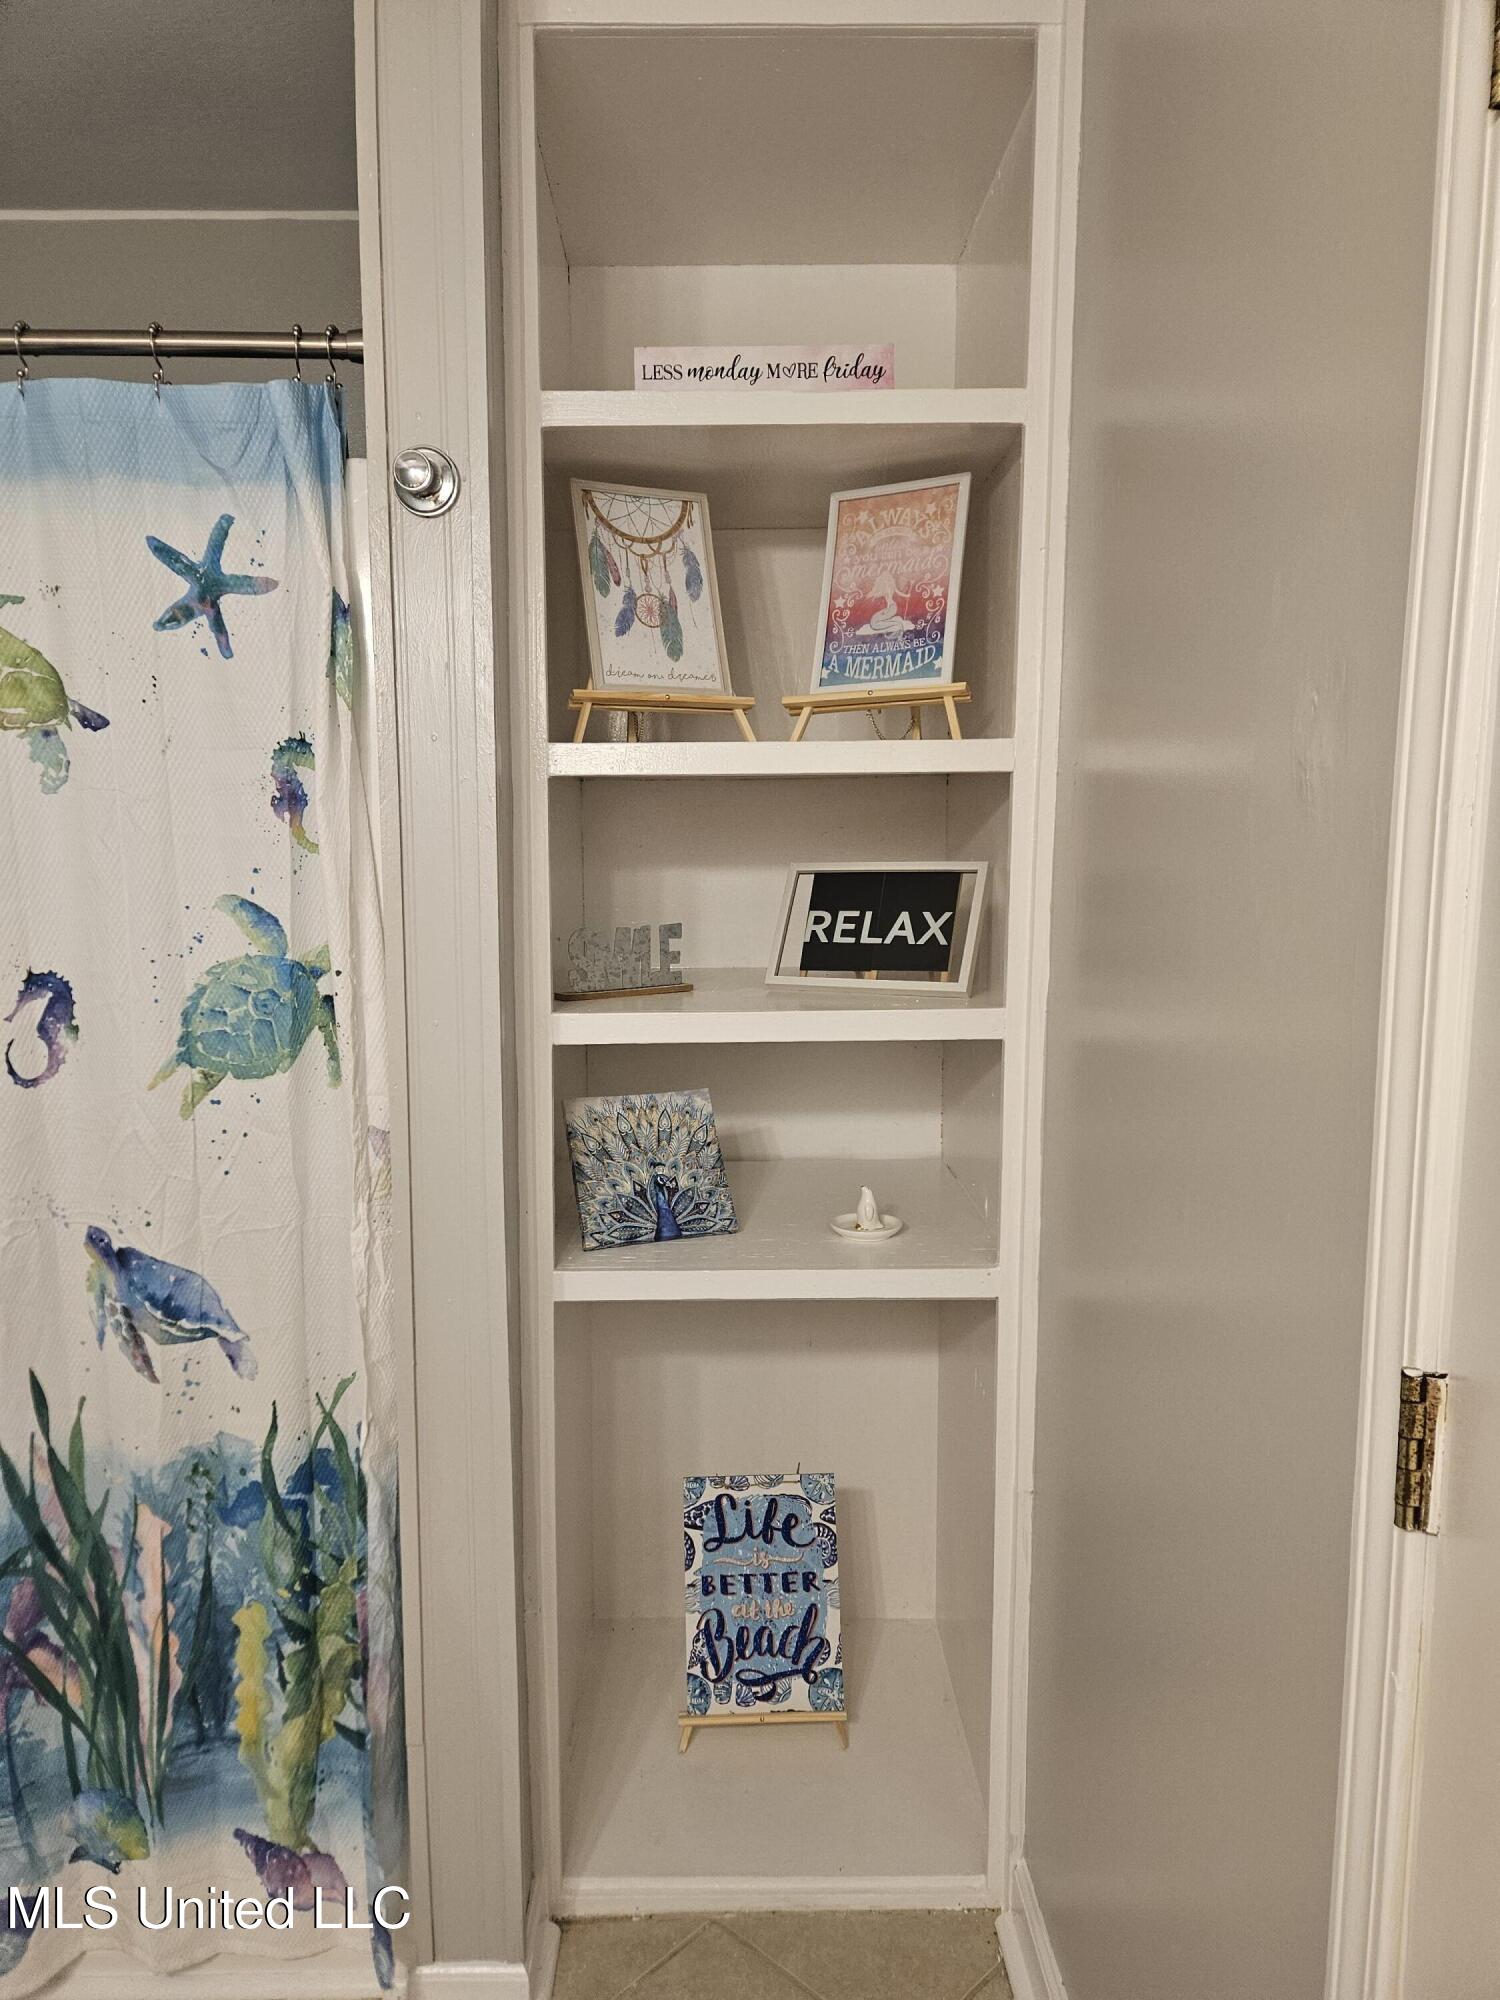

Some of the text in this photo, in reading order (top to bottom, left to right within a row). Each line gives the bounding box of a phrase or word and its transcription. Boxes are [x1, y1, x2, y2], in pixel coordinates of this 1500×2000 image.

[642, 364, 683, 381] LESS
[687, 354, 763, 386] monday
[823, 352, 887, 383] friday
[856, 507, 931, 547] ALWAYS
[828, 645, 936, 681] A MERMAID
[843, 637, 926, 655] THEN ALWAYS BE
[803, 909, 954, 947] RELAX
[703, 1493, 817, 1553] Life
[701, 1571, 821, 1597] BETTER
[732, 1600, 795, 1621] at the
[696, 1603, 826, 1686] Beach
